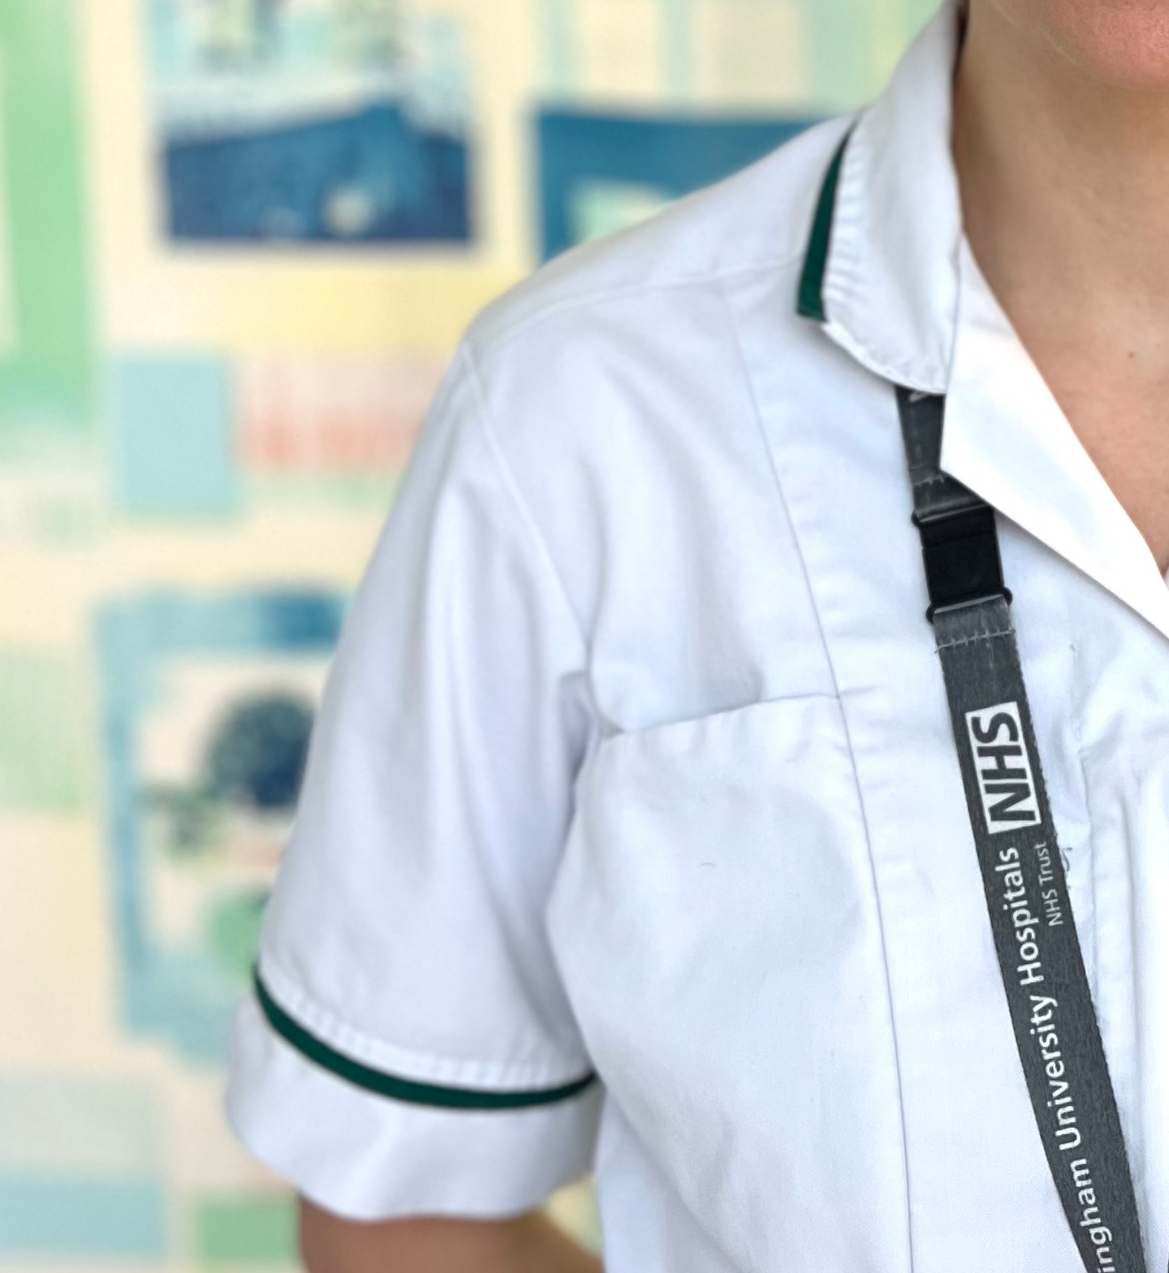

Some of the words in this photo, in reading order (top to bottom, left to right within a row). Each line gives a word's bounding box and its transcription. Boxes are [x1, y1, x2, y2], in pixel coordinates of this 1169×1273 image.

[971, 712, 1037, 822] NHS
[995, 846, 1045, 986] Hospitals
[1034, 840, 1054, 886] Trust
[1042, 888, 1064, 927] NHS
[1030, 995, 1083, 1151] University
